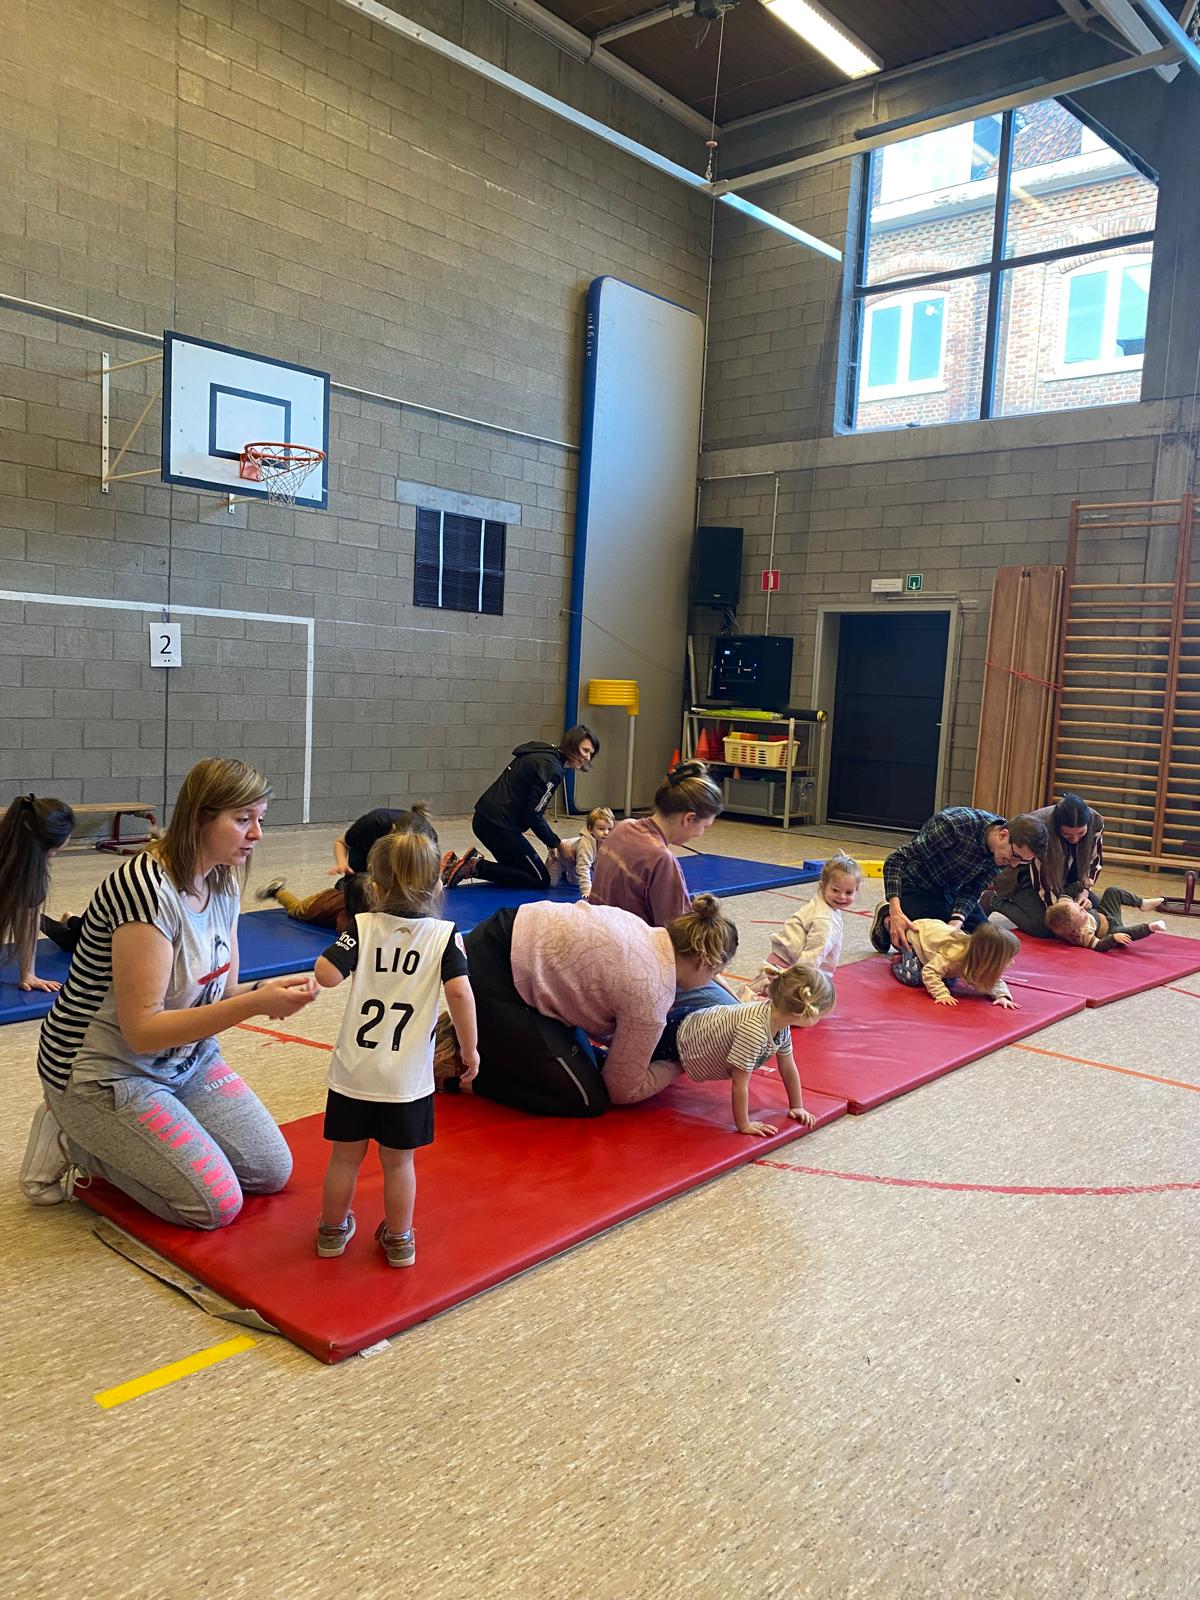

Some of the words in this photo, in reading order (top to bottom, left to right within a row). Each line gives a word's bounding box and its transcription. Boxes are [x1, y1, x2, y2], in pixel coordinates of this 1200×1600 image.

[160, 634, 172, 655] 2
[375, 947, 421, 976] LIO
[356, 998, 414, 1052] 27
